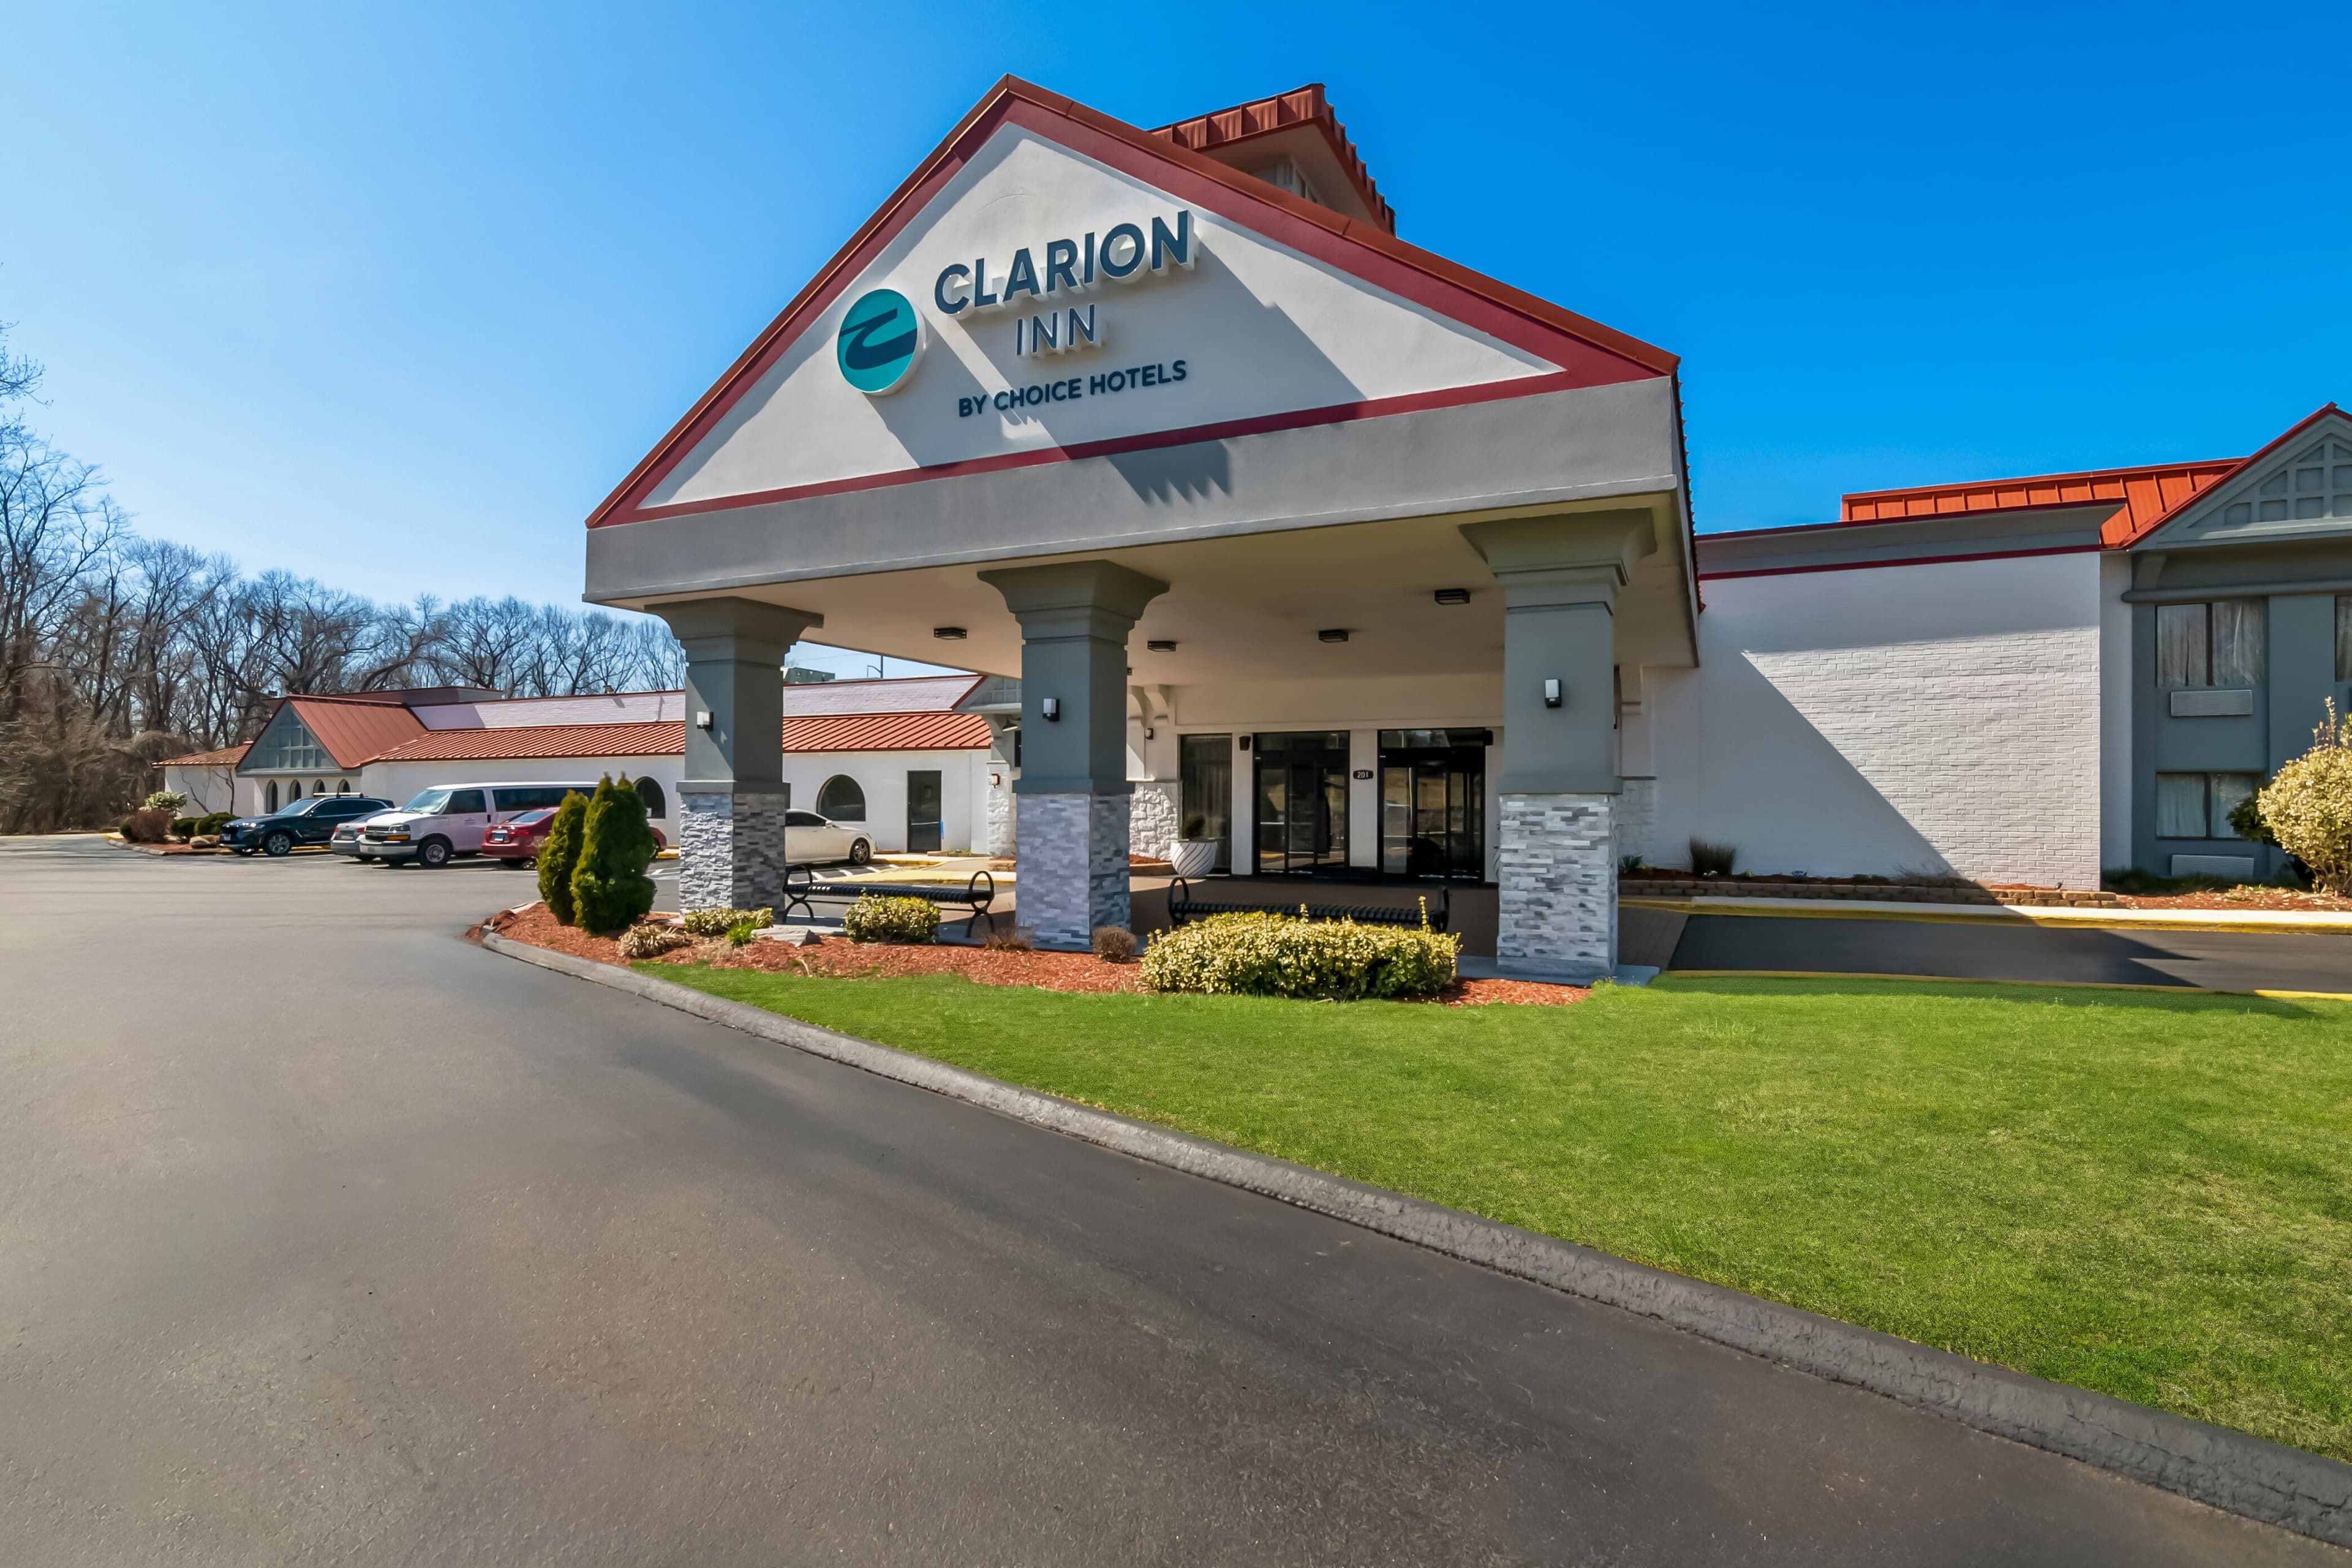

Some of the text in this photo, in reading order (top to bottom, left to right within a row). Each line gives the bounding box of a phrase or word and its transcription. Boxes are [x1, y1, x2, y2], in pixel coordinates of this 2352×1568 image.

[935, 210, 1188, 315] CLARION
[1017, 304, 1095, 355] INN
[959, 360, 1187, 417] BY CHOICE HOTELS
